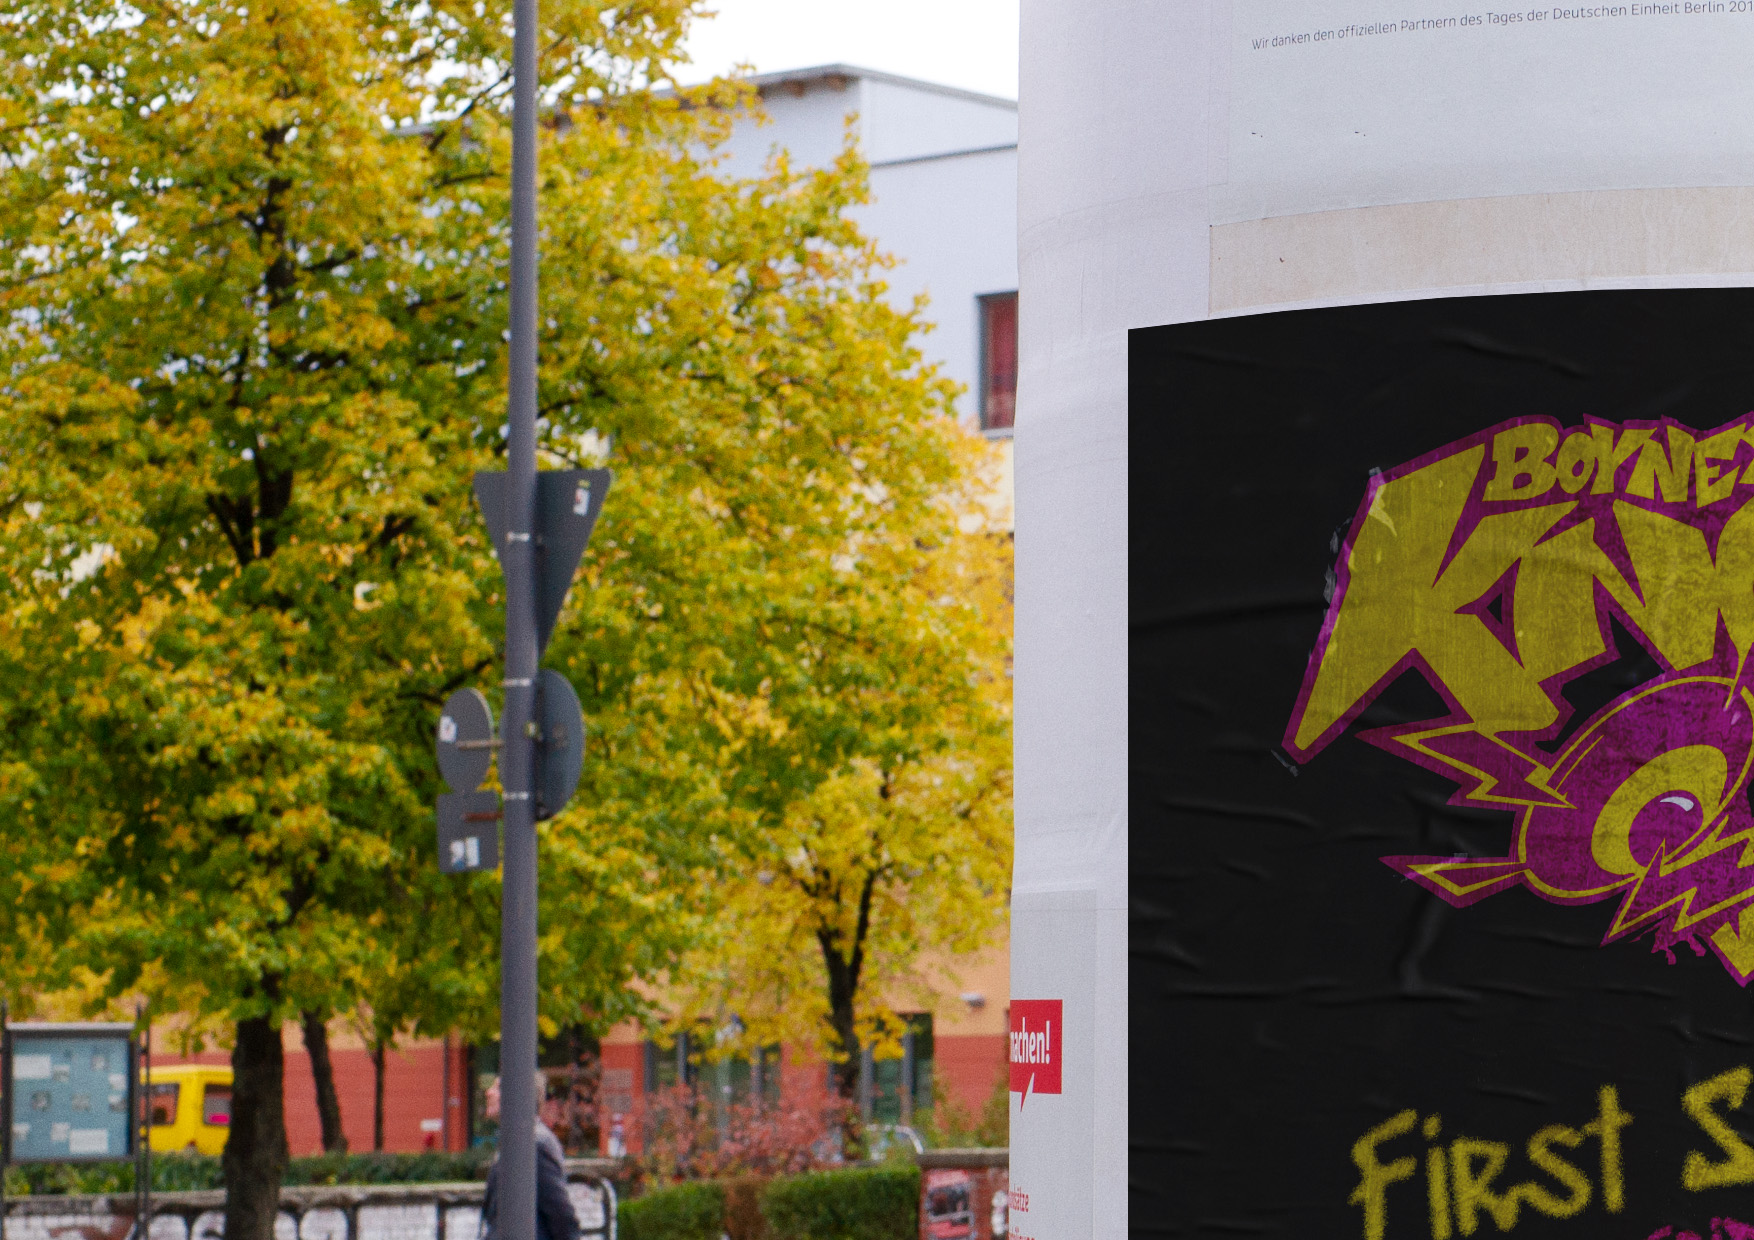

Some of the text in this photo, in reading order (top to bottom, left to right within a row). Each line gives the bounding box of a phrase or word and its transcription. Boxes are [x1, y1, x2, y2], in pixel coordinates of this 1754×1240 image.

[1252, 37, 1268, 50] Wir
[1271, 33, 1310, 47] danken
[1313, 29, 1335, 42] den
[1337, 22, 1397, 39] offiziellen
[1400, 16, 1456, 32] Partnern
[1460, 13, 1482, 27] des
[1486, 10, 1523, 26] Tages
[1527, 8, 1549, 21] der
[1553, 3, 1627, 20] Deutschen
[1631, 1, 1680, 16] Einheit
[1684, 0, 1724, 14] Berlin
